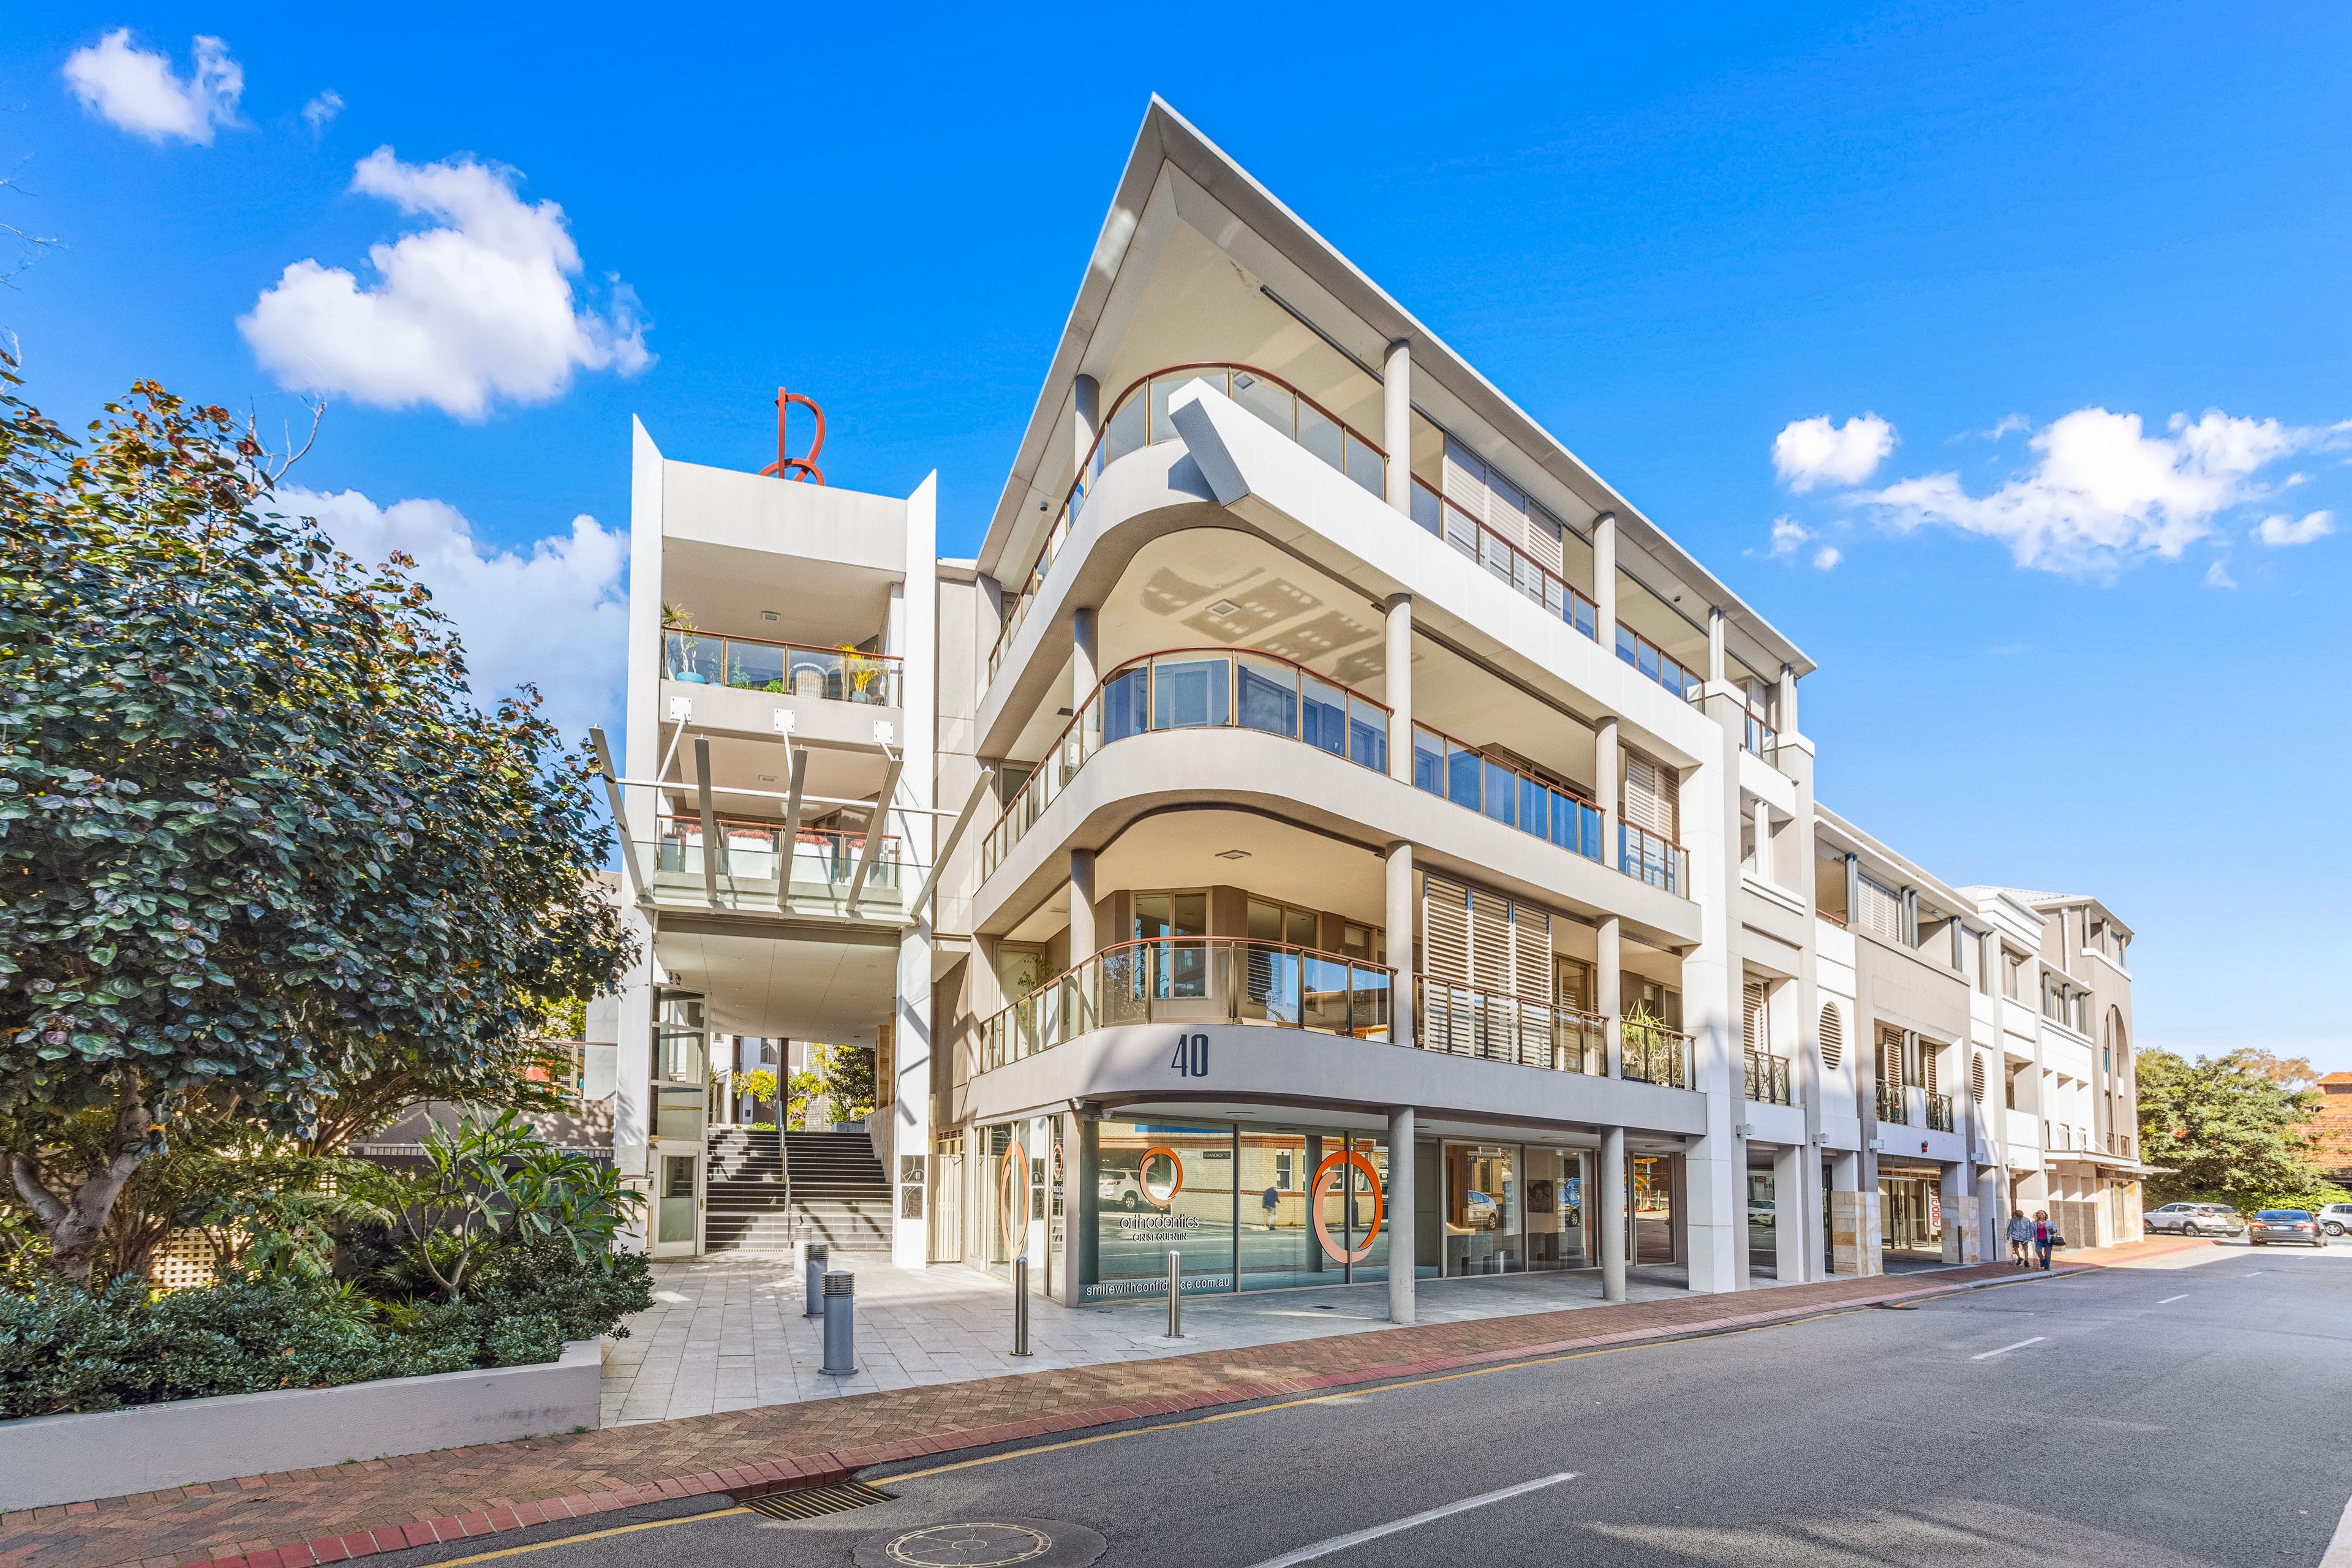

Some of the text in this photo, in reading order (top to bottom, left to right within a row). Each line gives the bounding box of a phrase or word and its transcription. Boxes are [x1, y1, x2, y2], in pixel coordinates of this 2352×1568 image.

[1170, 1034, 1209, 1077] 40
[1120, 1213, 1199, 1229] orthodontics
[1133, 1232, 1188, 1242] ON ST QUENTIN
[1085, 1278, 1230, 1297] smilewithconfidce.com.au
